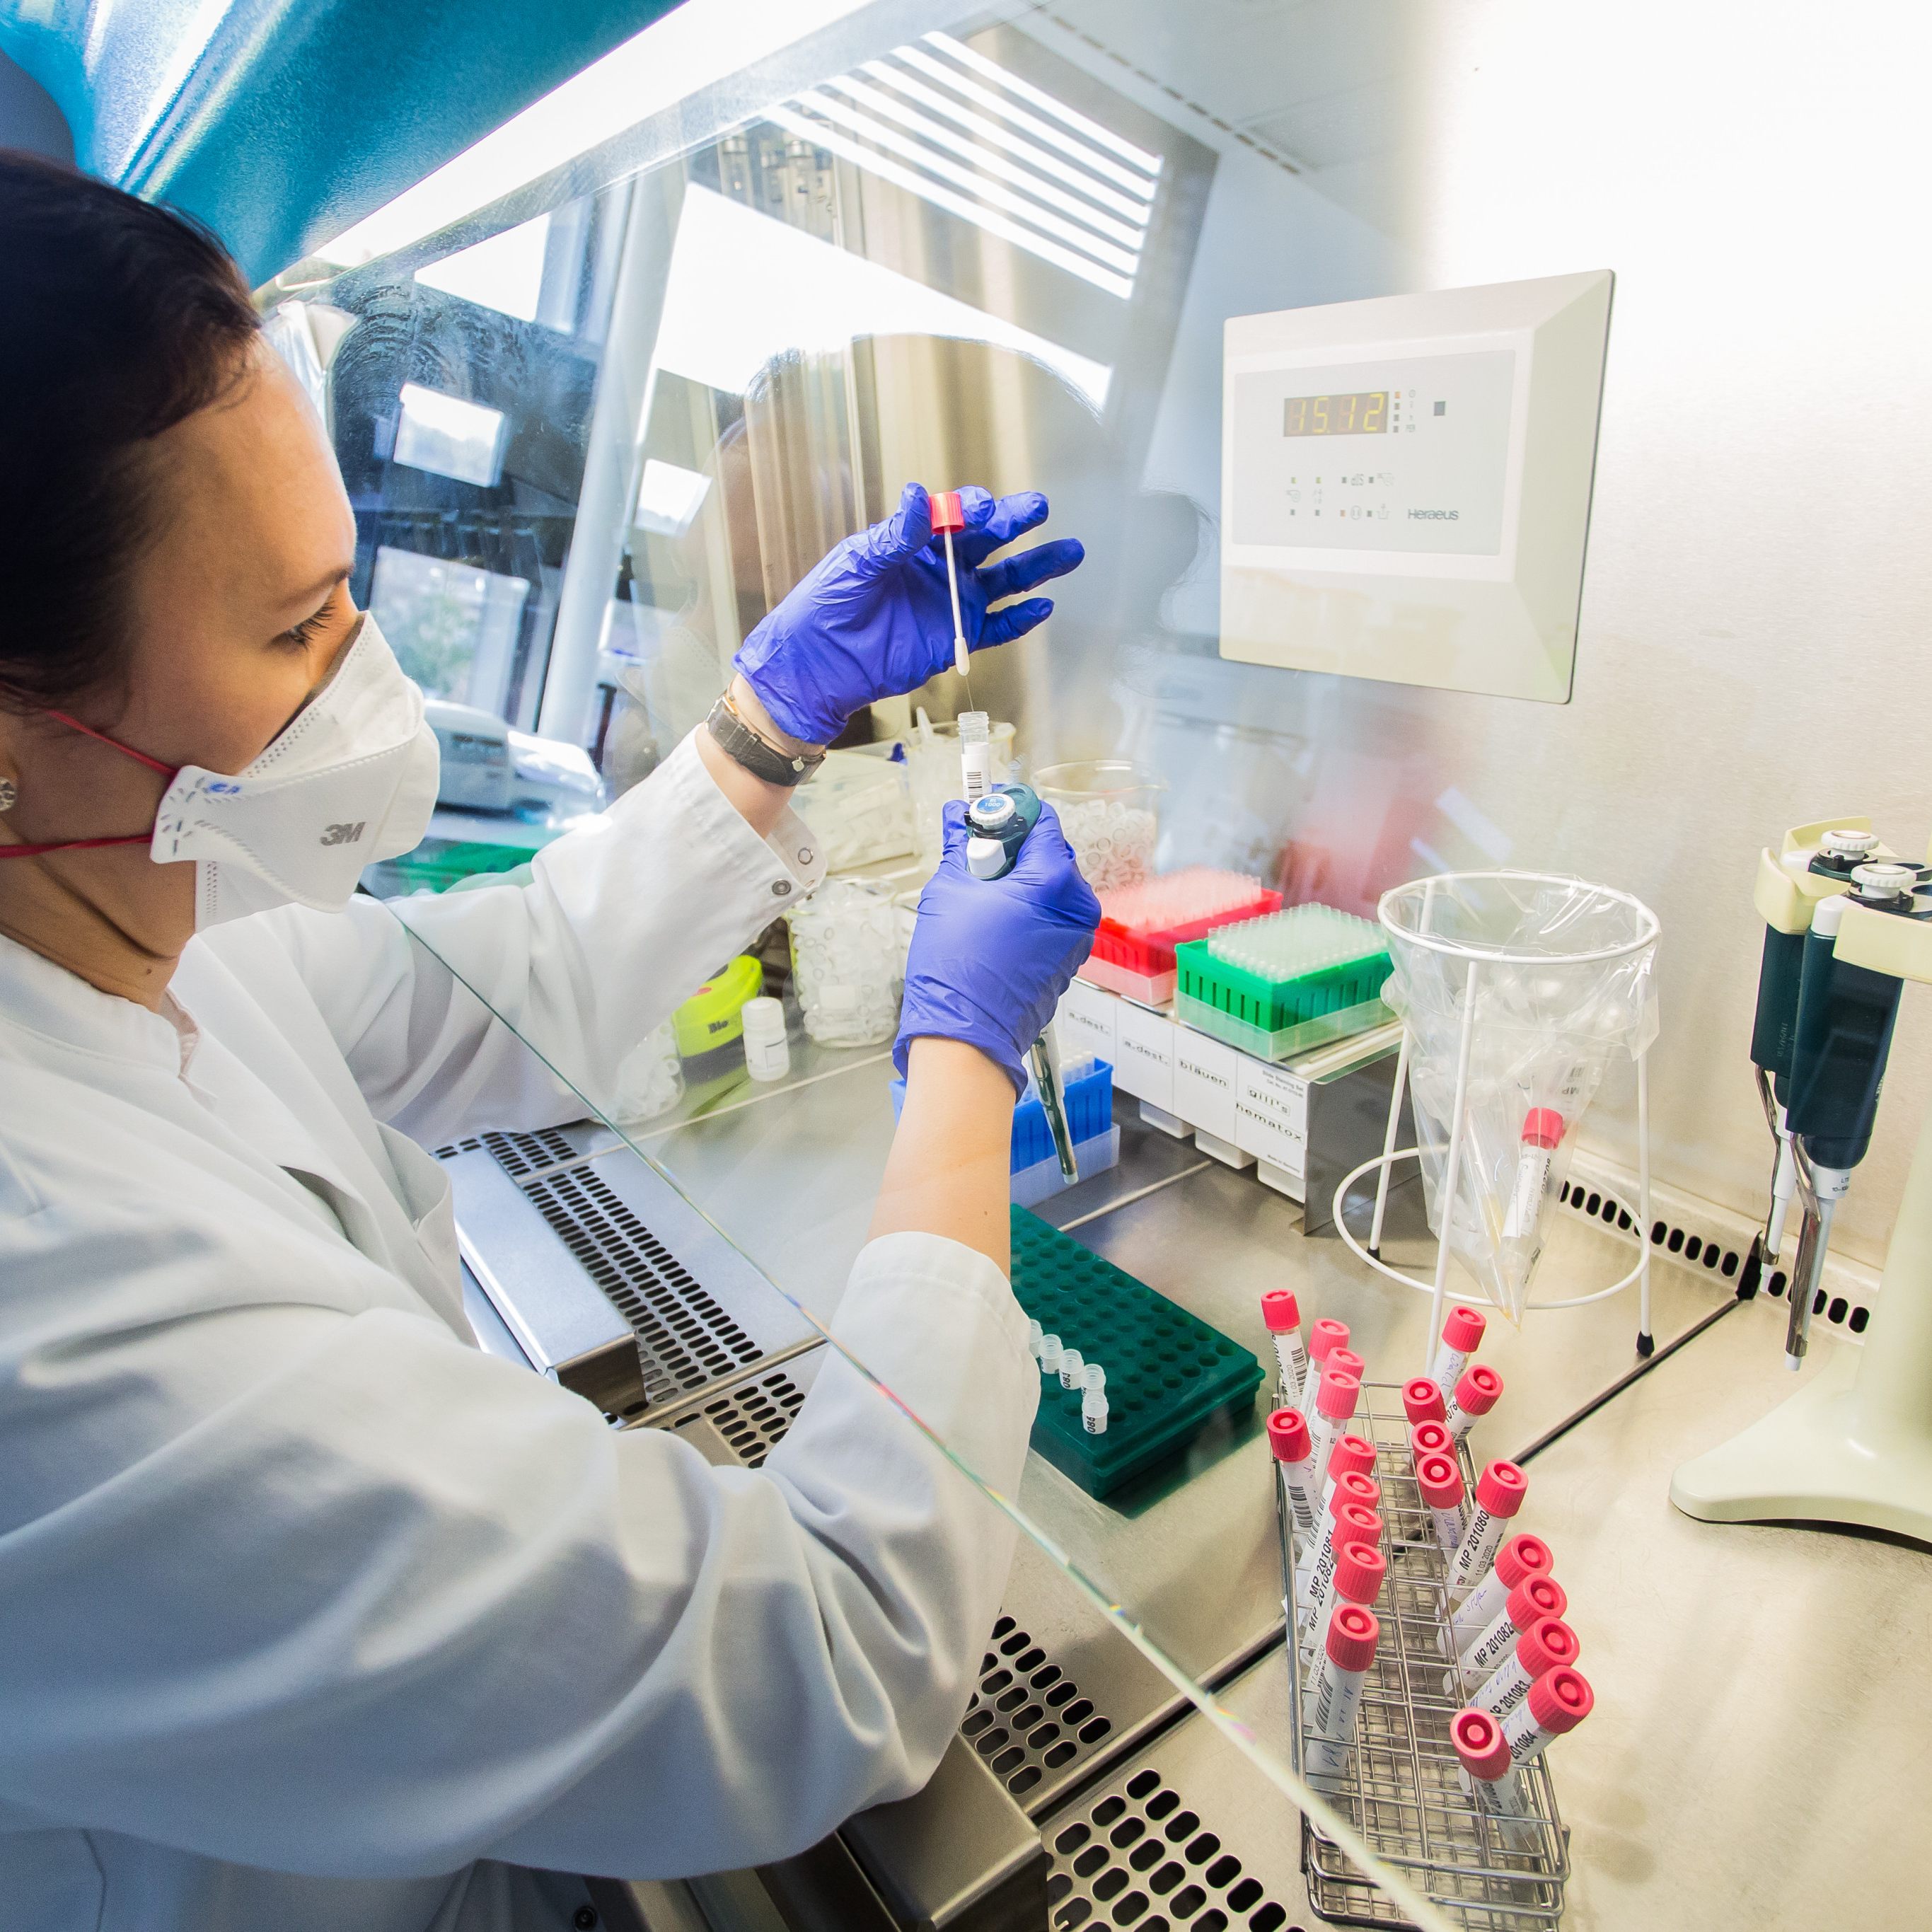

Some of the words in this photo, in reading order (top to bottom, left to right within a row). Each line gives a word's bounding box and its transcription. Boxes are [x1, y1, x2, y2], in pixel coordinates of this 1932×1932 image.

[1407, 508, 1459, 521] Heraeus
[320, 821, 367, 846] 3M
[1249, 1089, 1288, 1114] gill's
[1235, 1102, 1302, 1142] hematox
[1459, 1549, 1473, 1571] MP
[1467, 1510, 1490, 1552] 201080
[1309, 1575, 1321, 1598] MP
[1317, 1529, 1334, 1575] 201081
[1308, 1607, 1319, 1631] MP
[1474, 1648, 1488, 1668] MP
[1486, 1621, 1515, 1655] 201082
[1499, 1679, 1531, 1710] 201083
